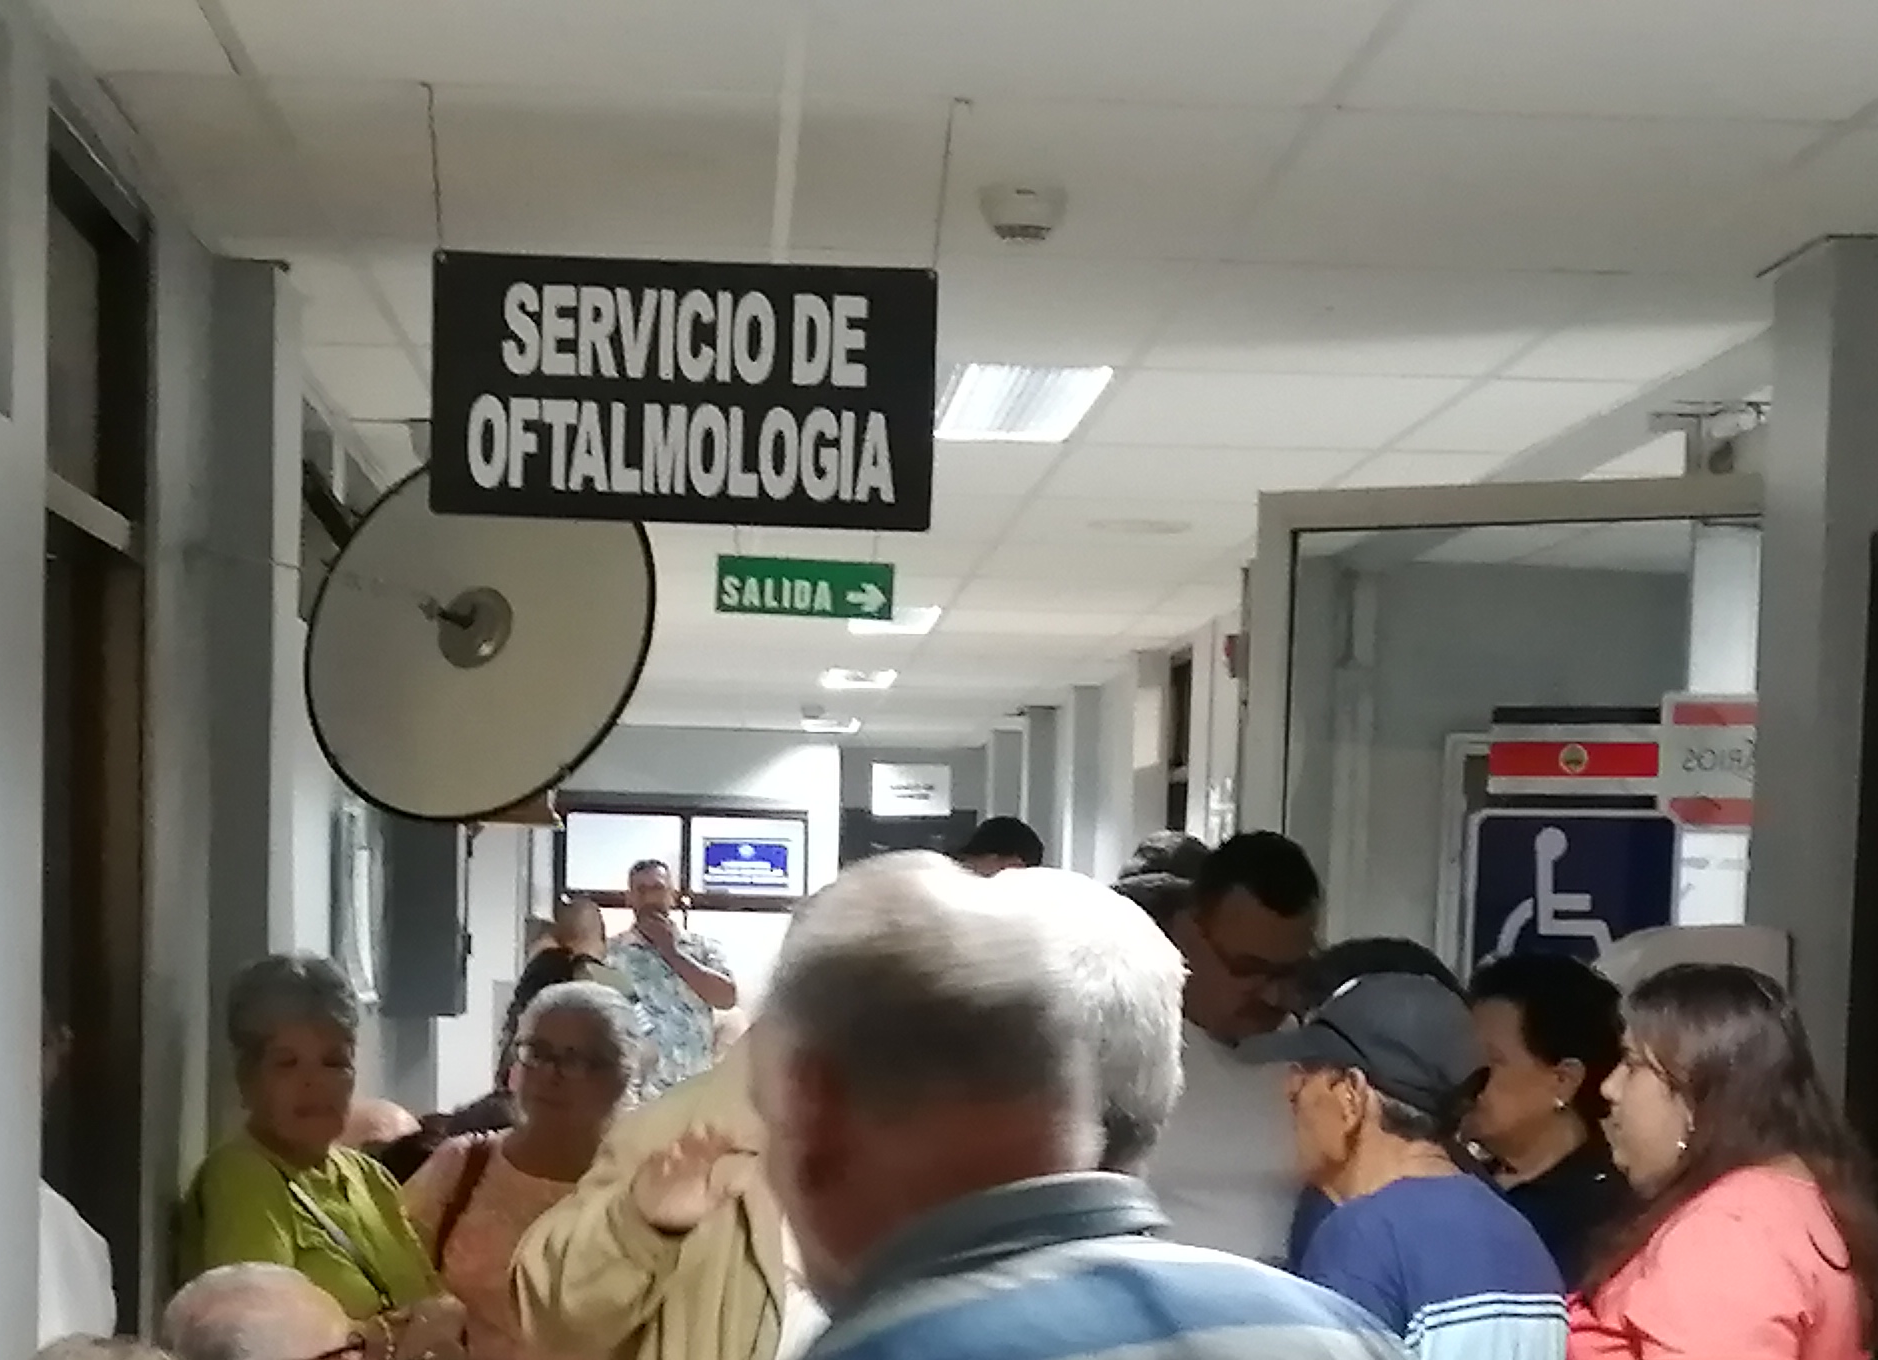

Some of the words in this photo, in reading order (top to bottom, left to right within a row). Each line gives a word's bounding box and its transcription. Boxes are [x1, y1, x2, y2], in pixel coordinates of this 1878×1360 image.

[501, 281, 775, 385] SERVICIO
[791, 293, 869, 387] DE
[467, 393, 895, 504] OFTALMOLOGIA
[721, 575, 832, 613] SALIDA
